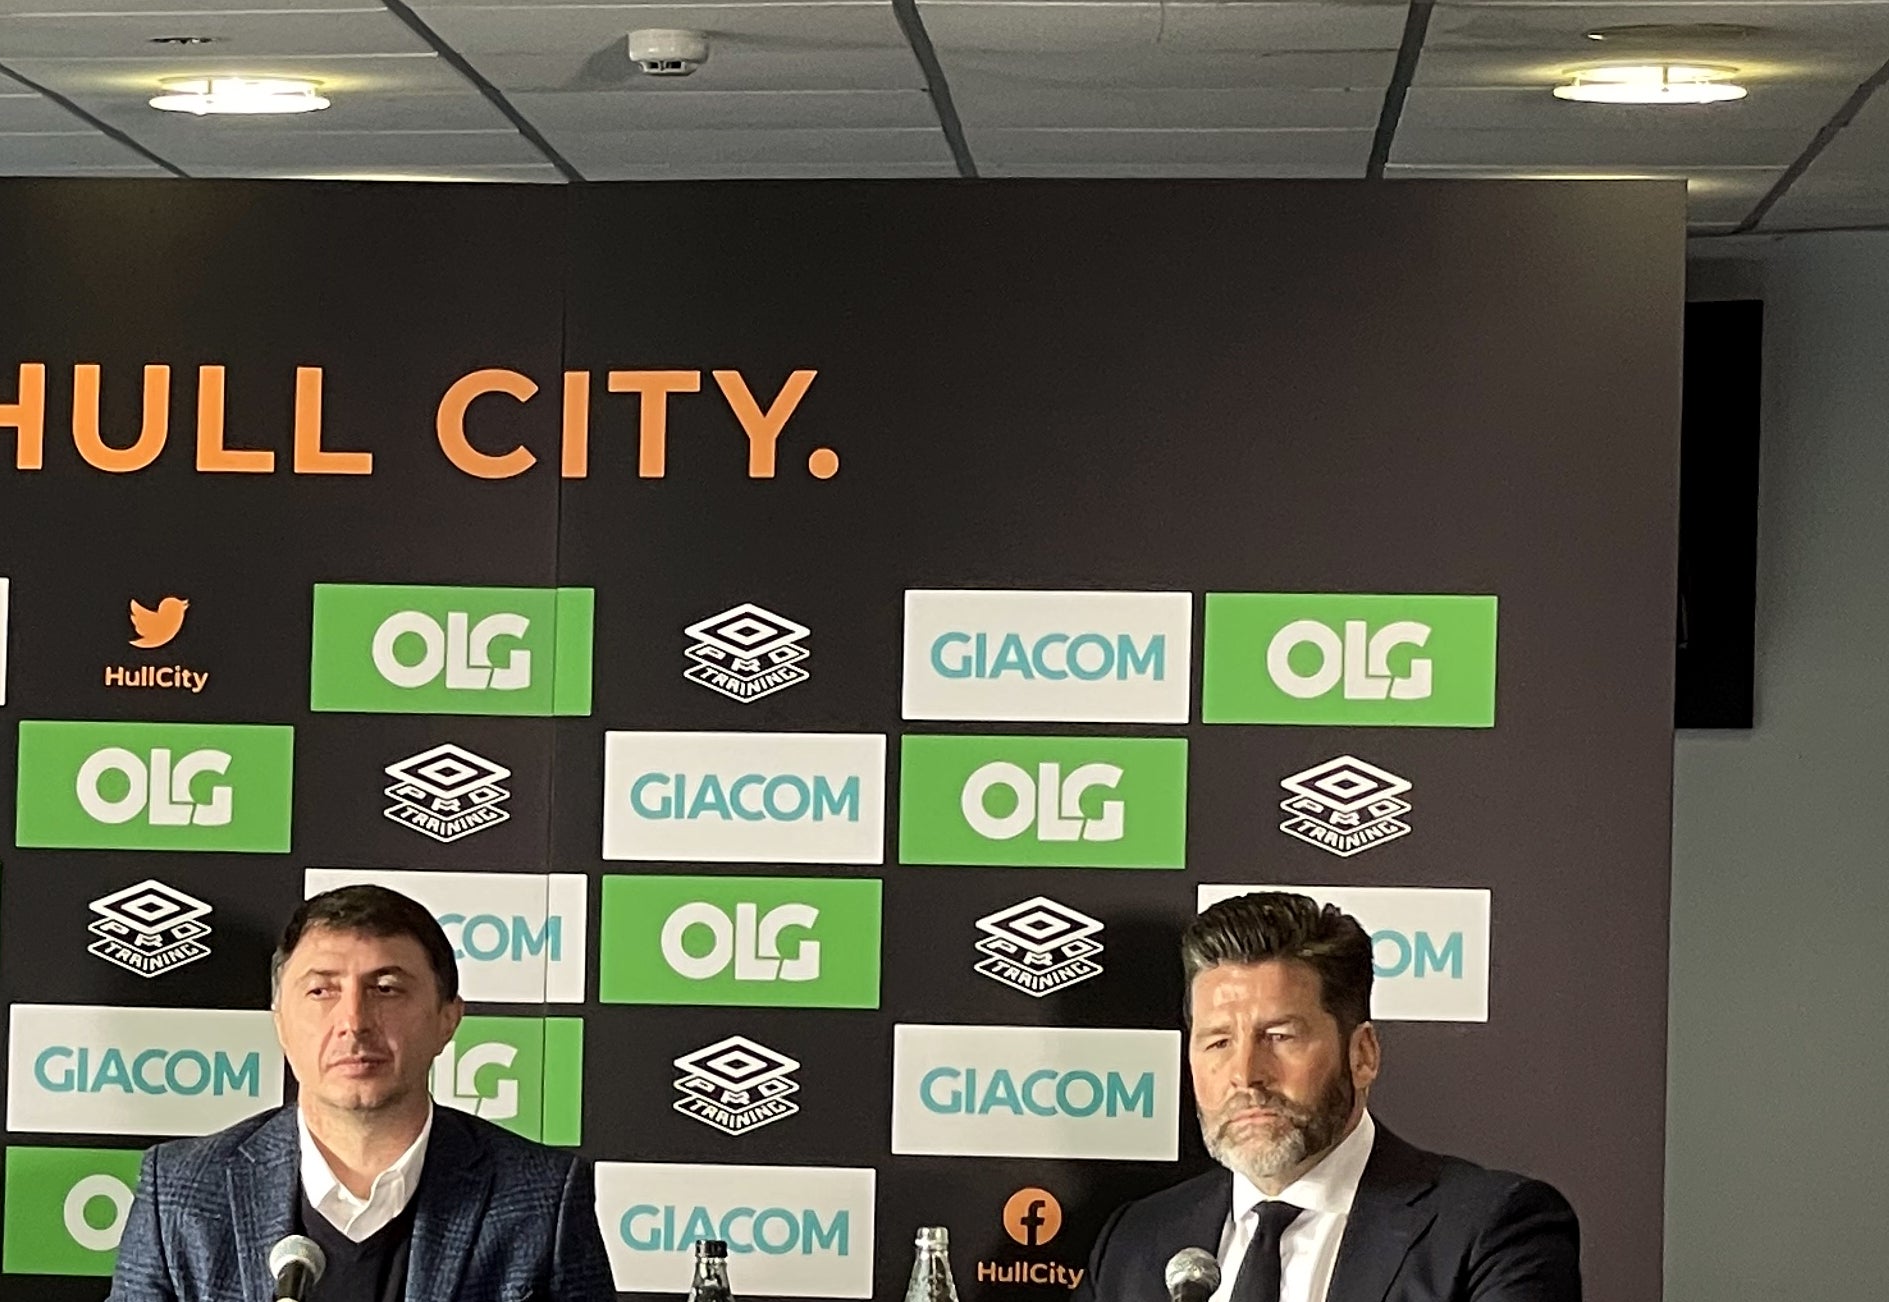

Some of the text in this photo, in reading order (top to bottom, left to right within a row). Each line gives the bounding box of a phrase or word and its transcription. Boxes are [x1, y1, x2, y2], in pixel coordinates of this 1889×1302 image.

[435, 369, 840, 479] CITY.
[372, 611, 531, 689] OLG
[694, 645, 802, 674] PRO
[932, 633, 1164, 679] GIACOM
[1267, 620, 1431, 699] OLG
[105, 666, 208, 692] HullCity
[699, 666, 799, 698] TRAINING
[77, 748, 232, 825] OLG
[394, 784, 503, 813] PRO
[632, 774, 858, 820] GIACOM
[961, 762, 1124, 841] OLG
[399, 805, 499, 837] TRAINING
[1291, 797, 1403, 827] PRO
[1295, 819, 1400, 852] TRAINING
[98, 920, 204, 948] PRO
[661, 902, 819, 981] OLG
[102, 941, 201, 972] TRAINING
[985, 938, 1095, 968] PRO
[989, 960, 1092, 992] TRAINING
[36, 1047, 259, 1094] GIACOM
[429, 1040, 518, 1121] LG
[683, 1077, 792, 1106] PRO
[921, 1068, 1153, 1116] GIACOM
[688, 1098, 788, 1130] TRAINING
[621, 1206, 848, 1254] GIACOM
[978, 1262, 1083, 1288] HullCity
